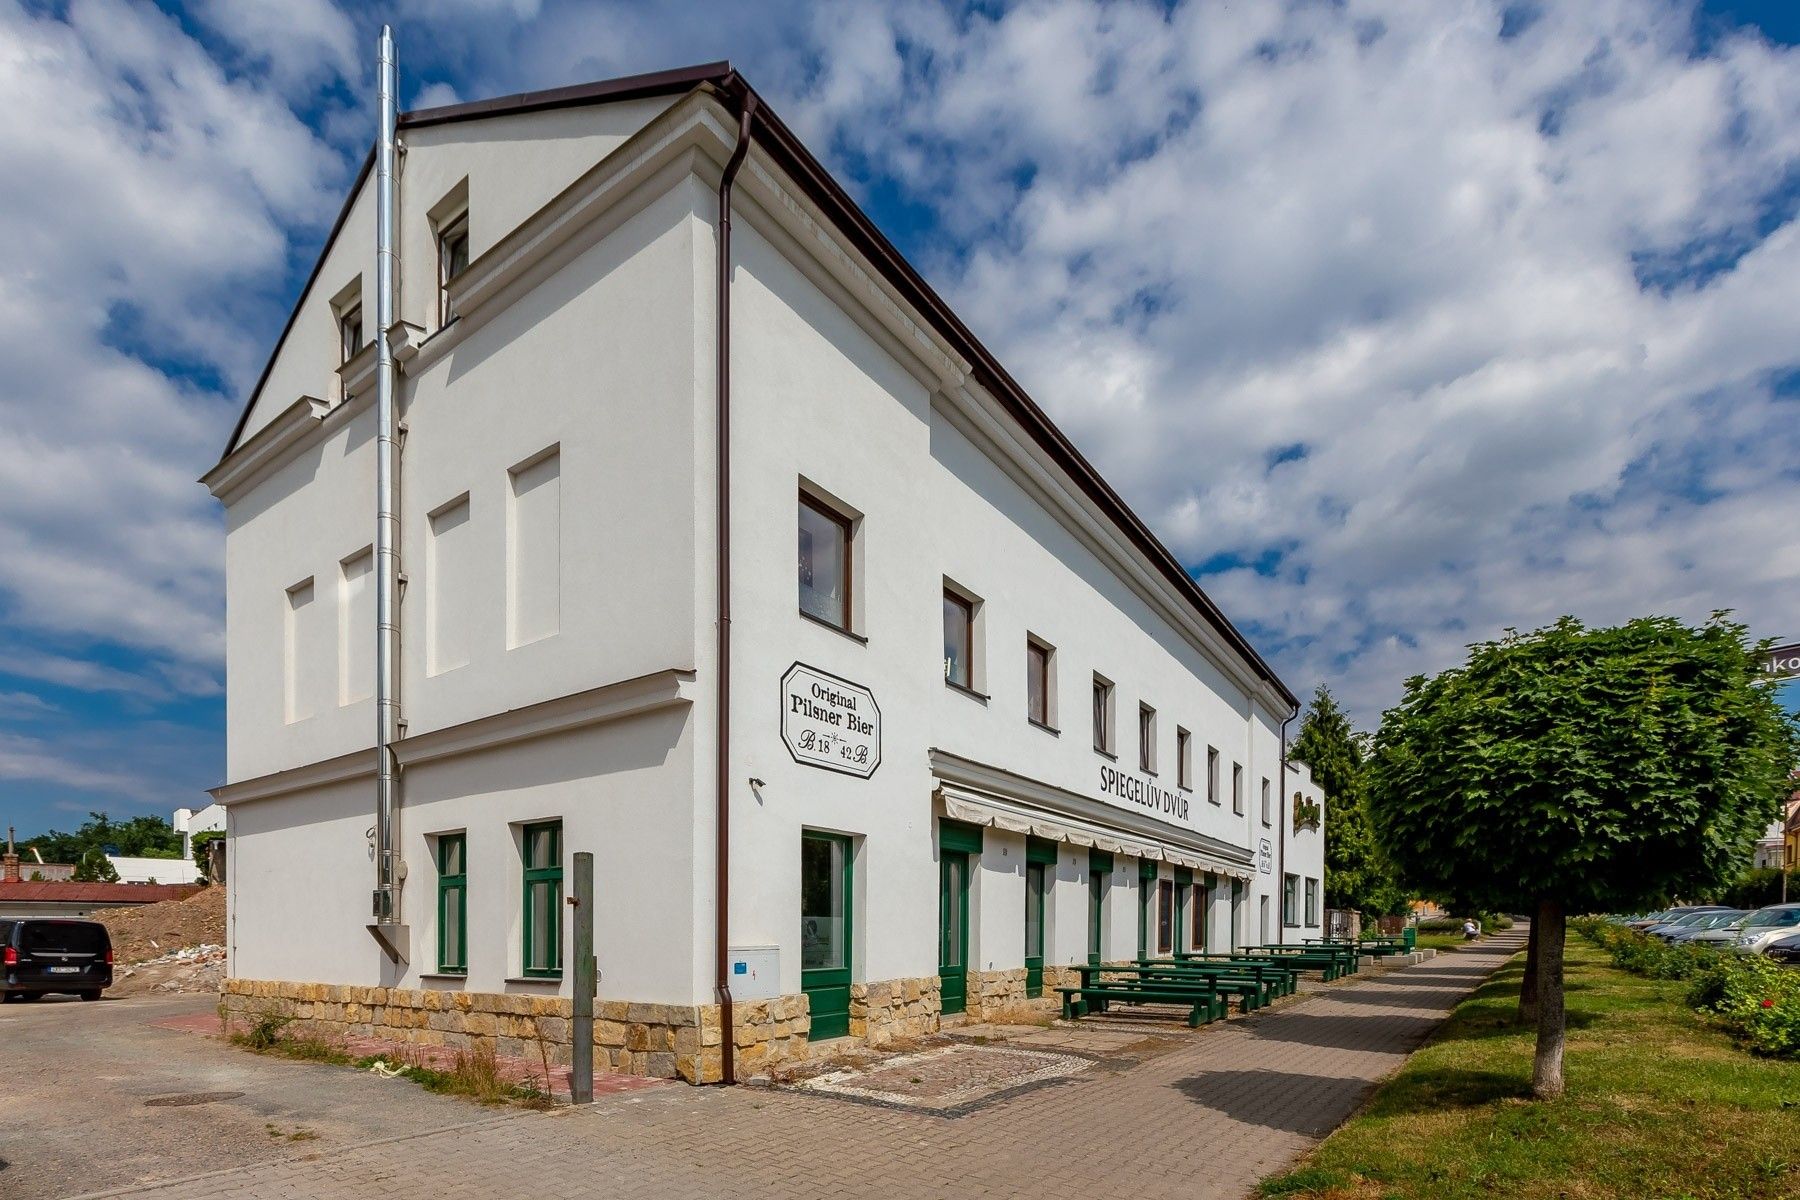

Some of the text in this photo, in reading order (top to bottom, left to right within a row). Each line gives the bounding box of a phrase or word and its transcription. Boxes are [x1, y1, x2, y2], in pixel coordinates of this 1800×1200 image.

[790, 693, 874, 736] Pilsner Bier
[811, 682, 857, 711] Original
[1100, 765, 1189, 821] SPIEGELŮV DVŮR
